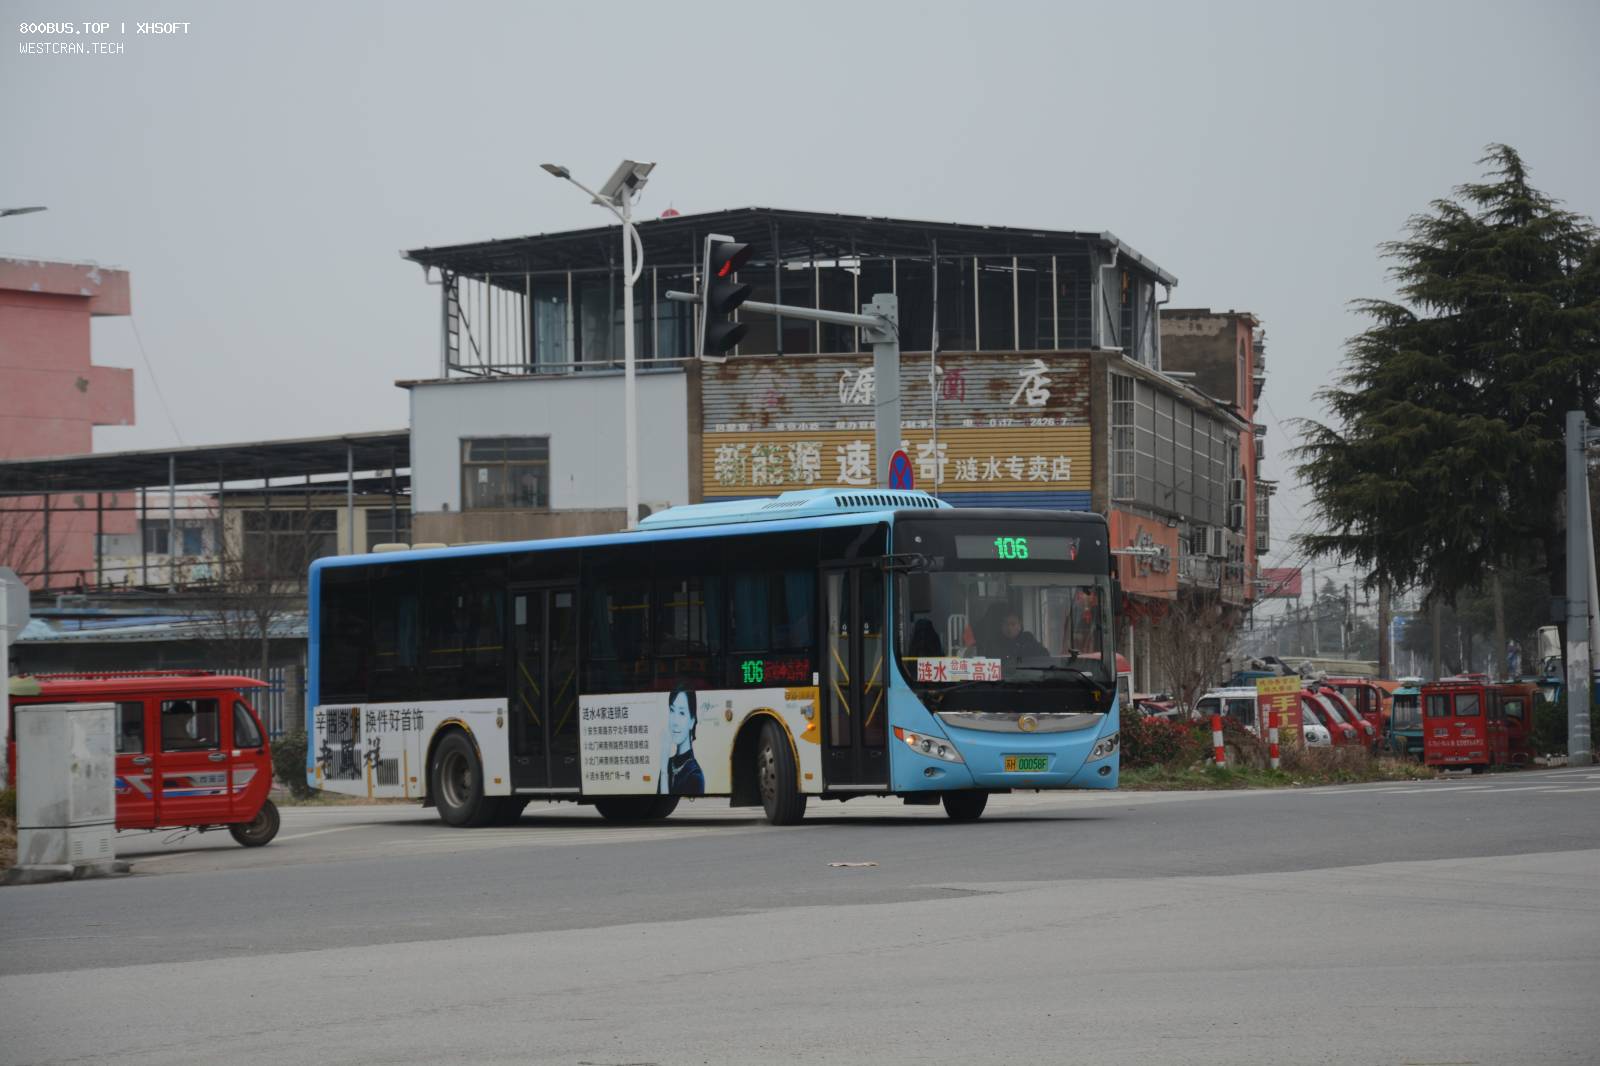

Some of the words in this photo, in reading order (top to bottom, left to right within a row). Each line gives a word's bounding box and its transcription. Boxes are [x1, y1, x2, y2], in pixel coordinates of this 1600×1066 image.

[836, 439, 949, 486] 速奇
[955, 454, 1073, 483] 涟水专卖店
[994, 537, 1028, 559] 106
[741, 660, 764, 683] 106
[918, 661, 947, 681] 涟水
[972, 661, 1001, 681] 高沟
